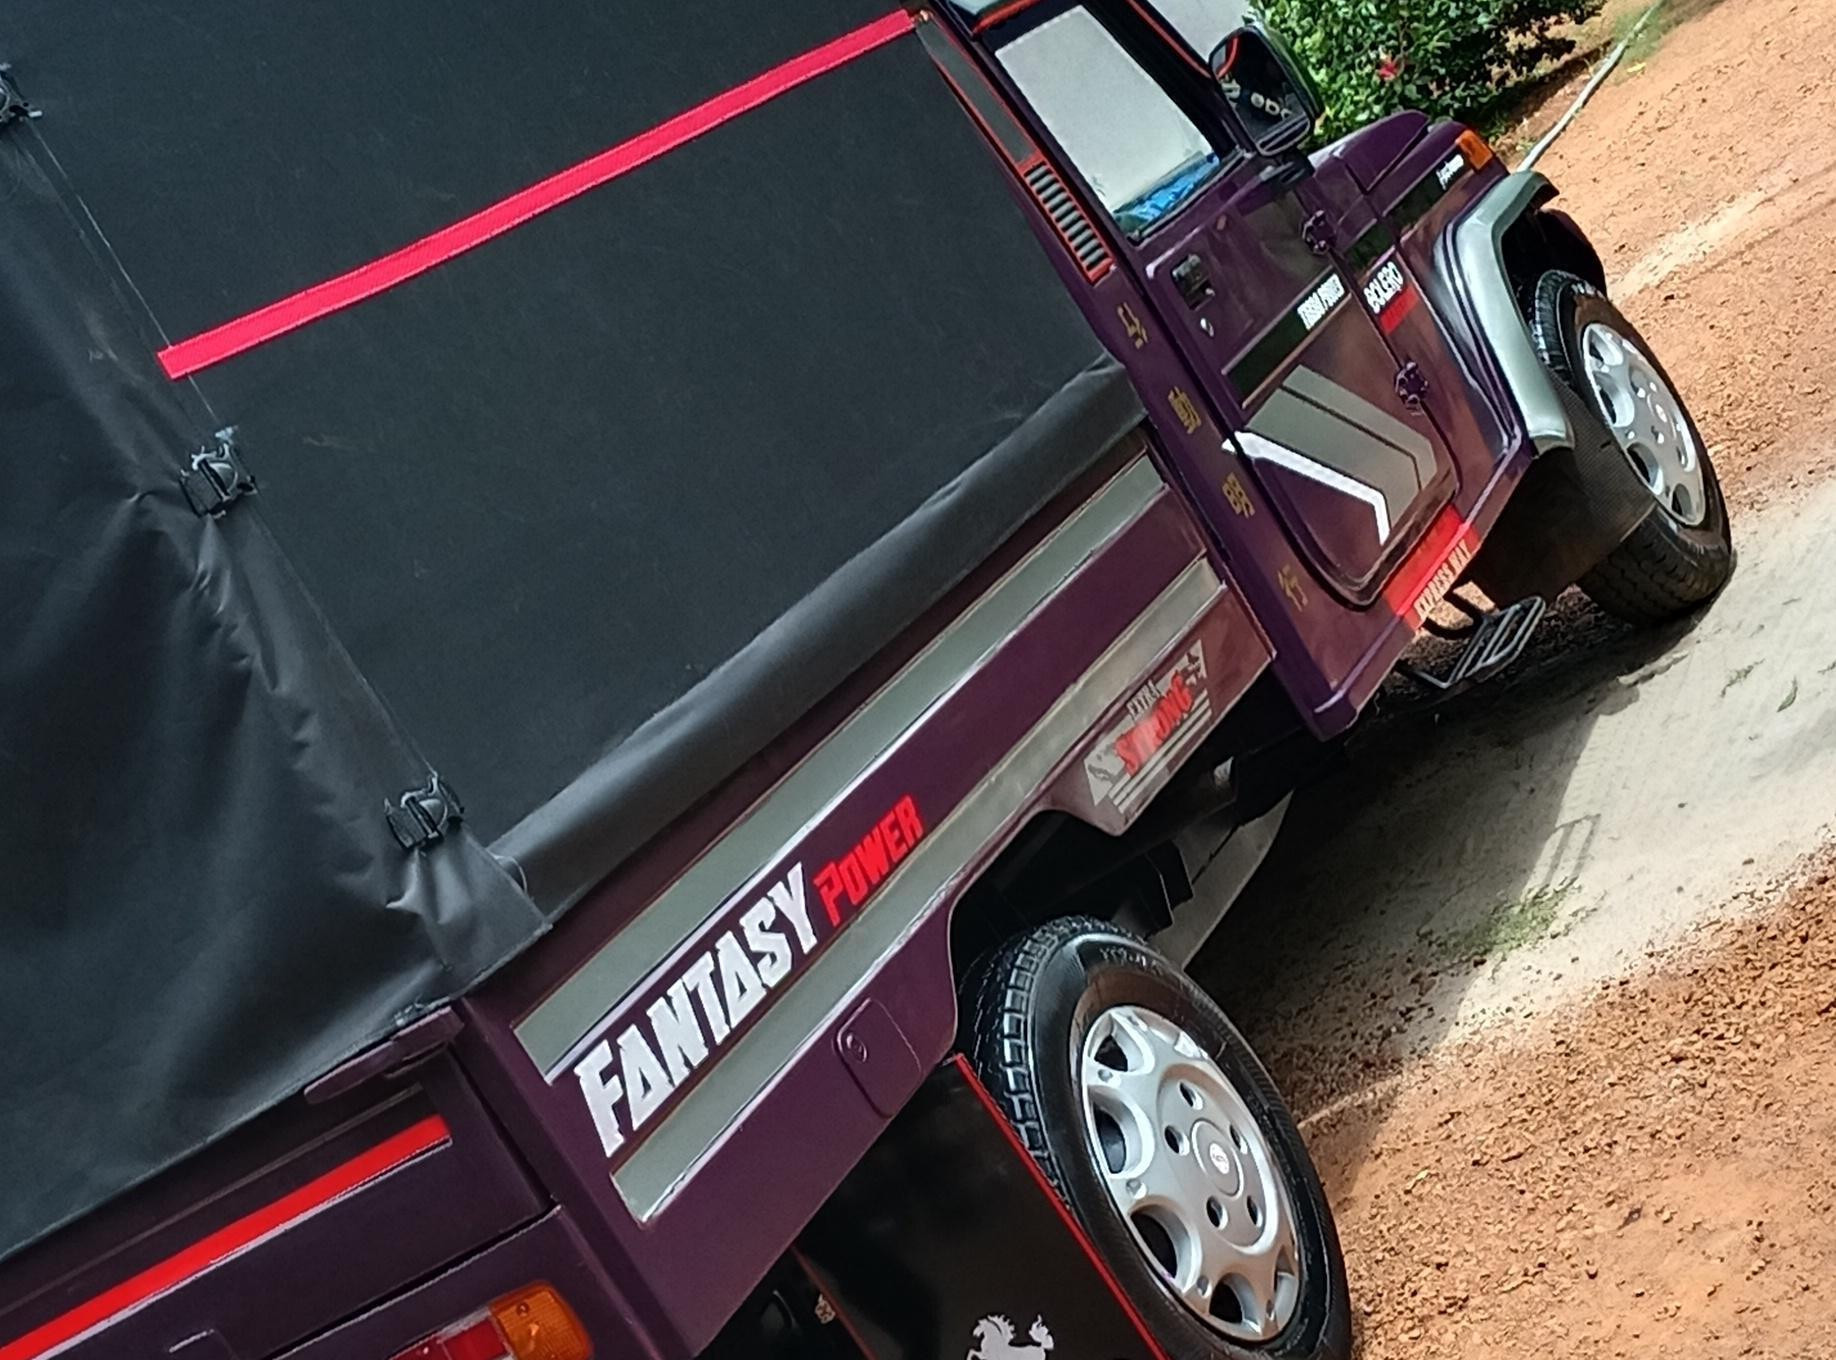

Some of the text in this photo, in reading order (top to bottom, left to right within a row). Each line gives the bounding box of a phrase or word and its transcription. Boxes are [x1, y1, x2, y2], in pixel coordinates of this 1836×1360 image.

[1363, 260, 1404, 315] BOLERO
[1413, 539, 1472, 622] EXPRESS WAY
[1113, 670, 1192, 776] STRONG
[573, 794, 925, 1158] FANTASY POWER
